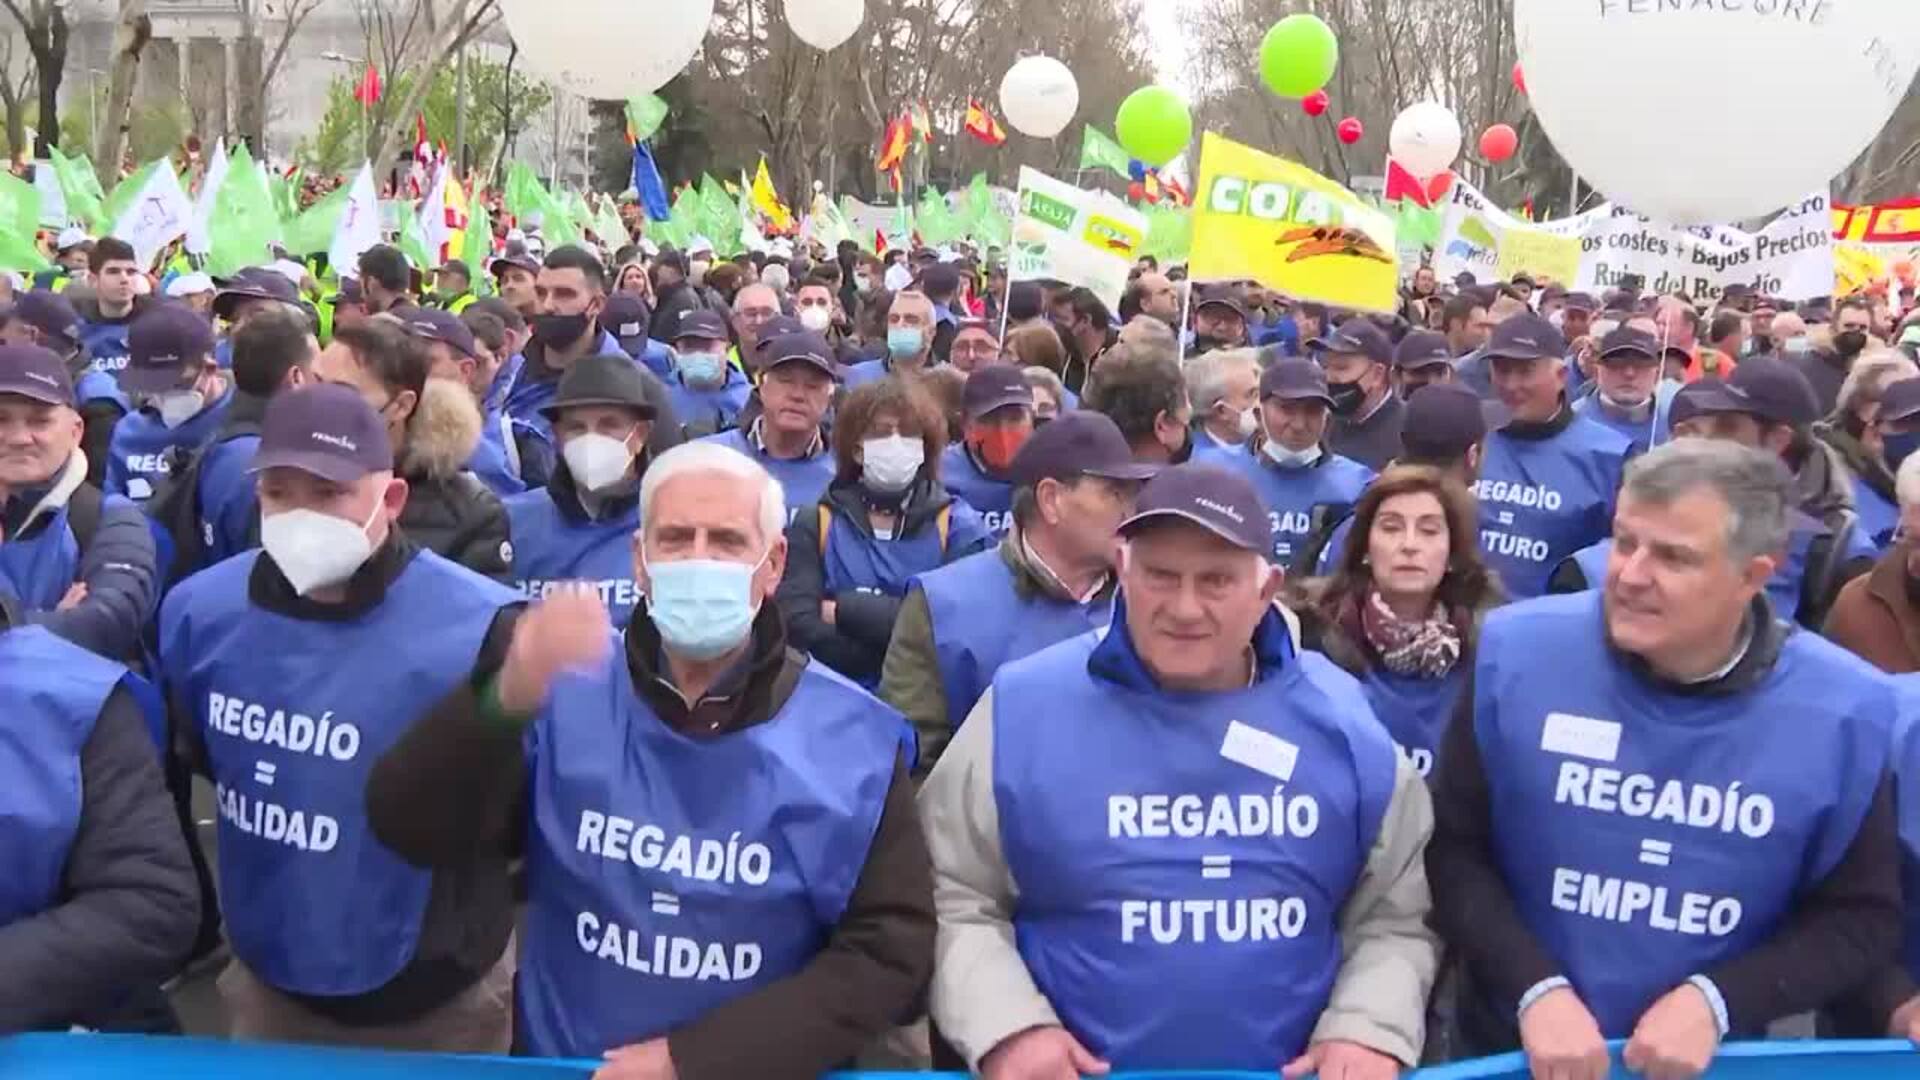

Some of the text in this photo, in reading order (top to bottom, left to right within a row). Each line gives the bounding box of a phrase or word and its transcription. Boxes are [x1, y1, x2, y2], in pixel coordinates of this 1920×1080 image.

[1608, 229, 1669, 256] costes
[1692, 243, 1750, 273] Bajos
[1756, 225, 1828, 261] Precios
[1653, 271, 1687, 293] del
[1481, 530, 1550, 562] TURO
[209, 692, 360, 761] REGADÍO
[254, 760, 277, 786] =
[217, 781, 339, 852] CALIDAD
[1108, 784, 1320, 839] REGADÍO
[1554, 761, 1775, 838] REGADÍO
[577, 809, 772, 886] REGADÍO
[1202, 855, 1232, 879] =
[1639, 838, 1673, 867] =
[651, 891, 680, 916] =
[1121, 897, 1307, 944] FUTURO
[1551, 867, 1743, 937] EMPLEO
[576, 911, 763, 981] CALIDAD
